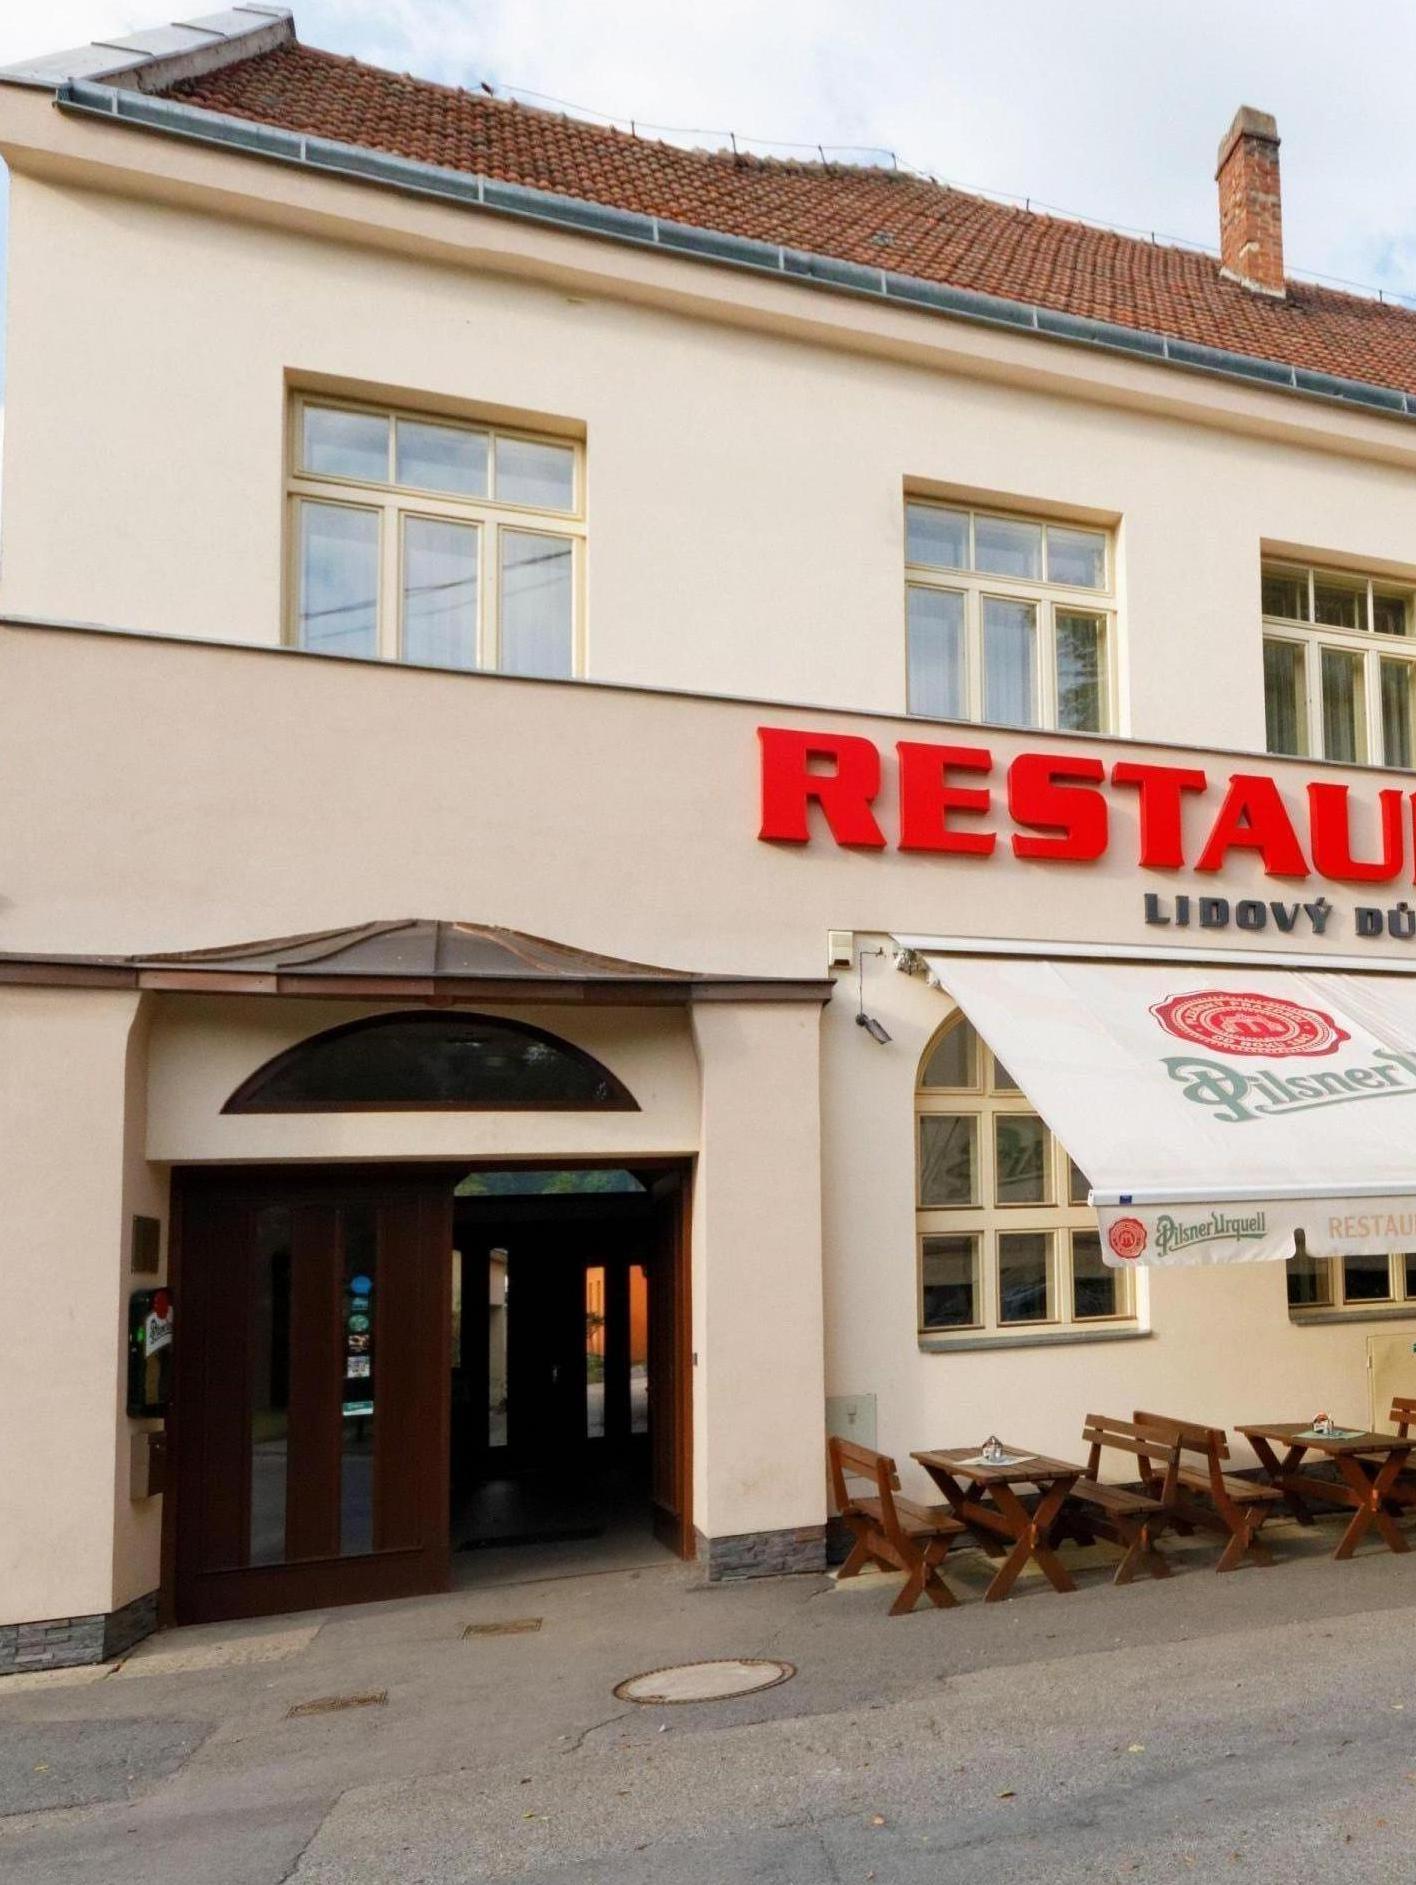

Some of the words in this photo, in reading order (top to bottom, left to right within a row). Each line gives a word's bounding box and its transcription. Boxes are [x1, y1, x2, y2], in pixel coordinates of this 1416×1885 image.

[1144, 893, 1333, 934] LIDOVÝ
[1159, 1056, 1402, 1123] Pilsner
[1155, 1215, 1213, 1258] Pilsner
[1211, 1211, 1265, 1242] Urquell
